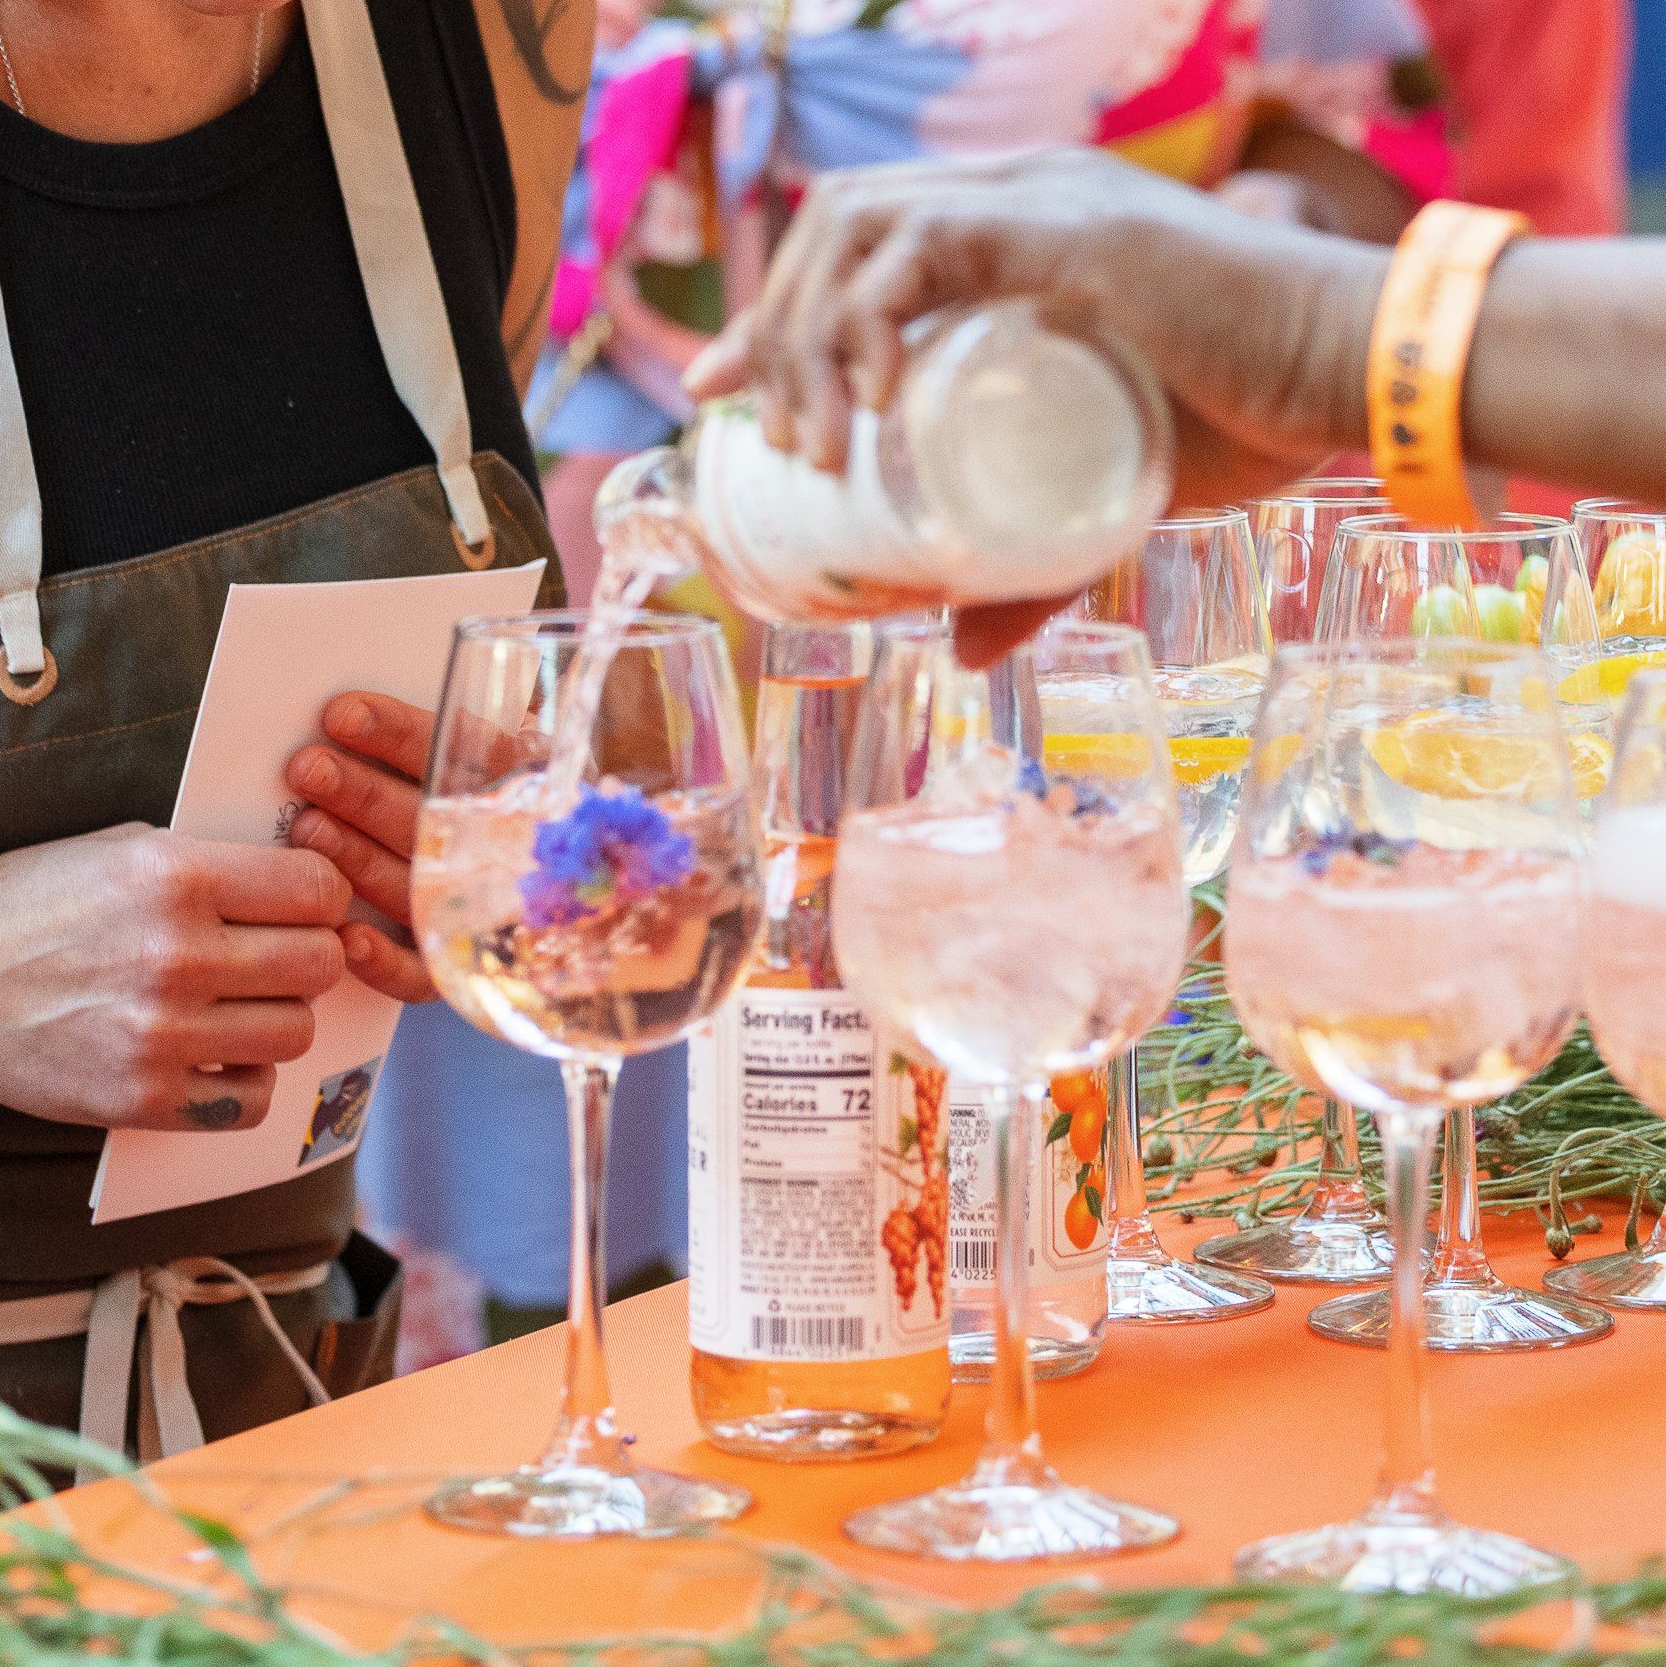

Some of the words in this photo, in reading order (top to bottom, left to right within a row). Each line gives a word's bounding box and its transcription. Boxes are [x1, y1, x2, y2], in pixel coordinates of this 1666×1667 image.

[742, 1006, 813, 1035] Serving
[743, 1093, 817, 1111] Calories
[843, 1089, 871, 1111] 72
[950, 1228, 967, 1237] EASE
[970, 1228, 996, 1237] RECYCL
